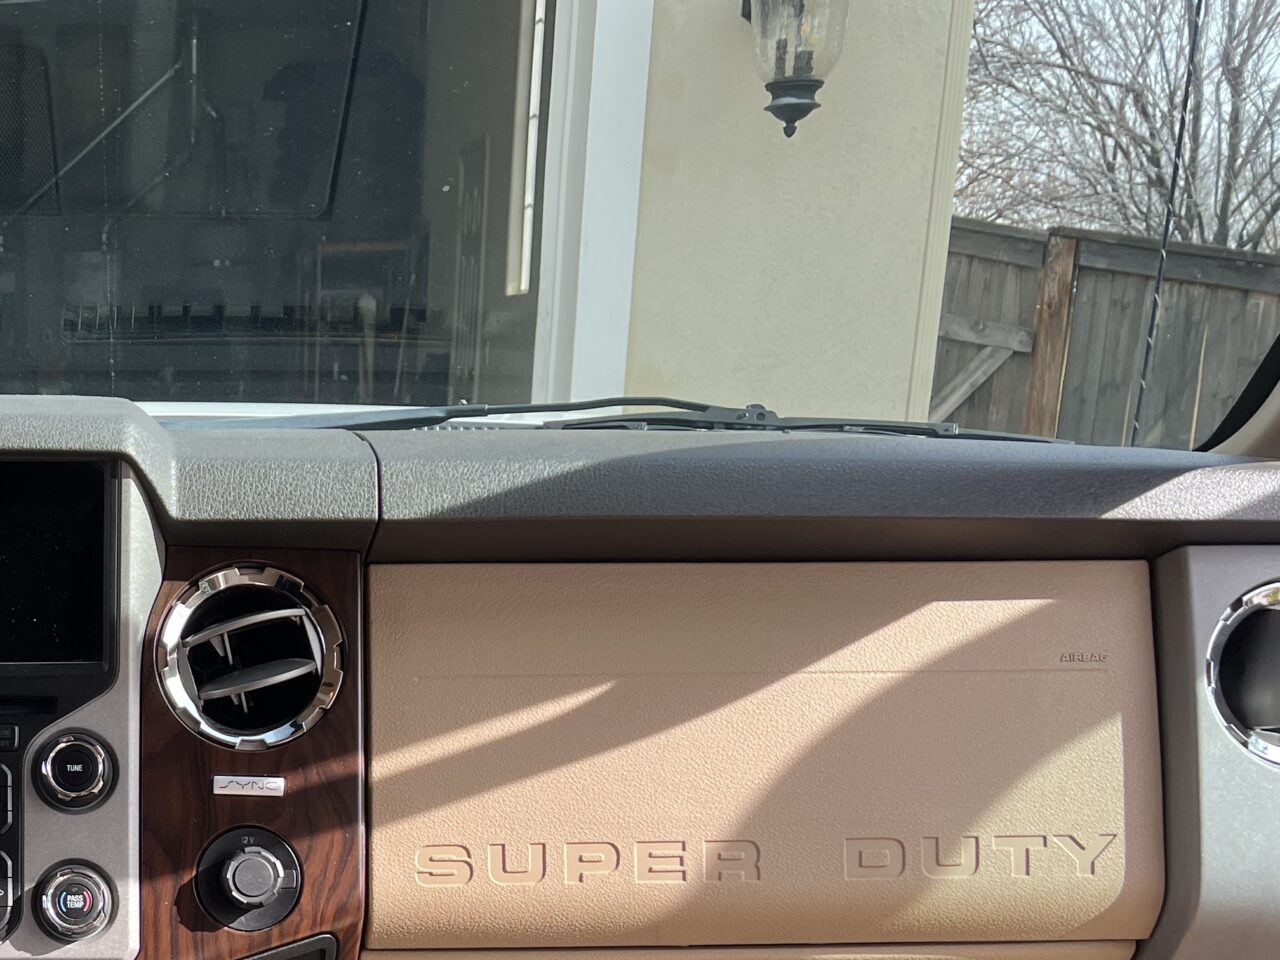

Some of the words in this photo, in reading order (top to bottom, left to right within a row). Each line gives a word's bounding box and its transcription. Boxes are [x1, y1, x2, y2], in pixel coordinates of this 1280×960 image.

[1059, 652, 1110, 663] AIRBAG
[219, 780, 278, 791] SYNC
[414, 838, 763, 887] SUPER
[843, 832, 1120, 882] DUTY
[67, 895, 83, 903] PASS
